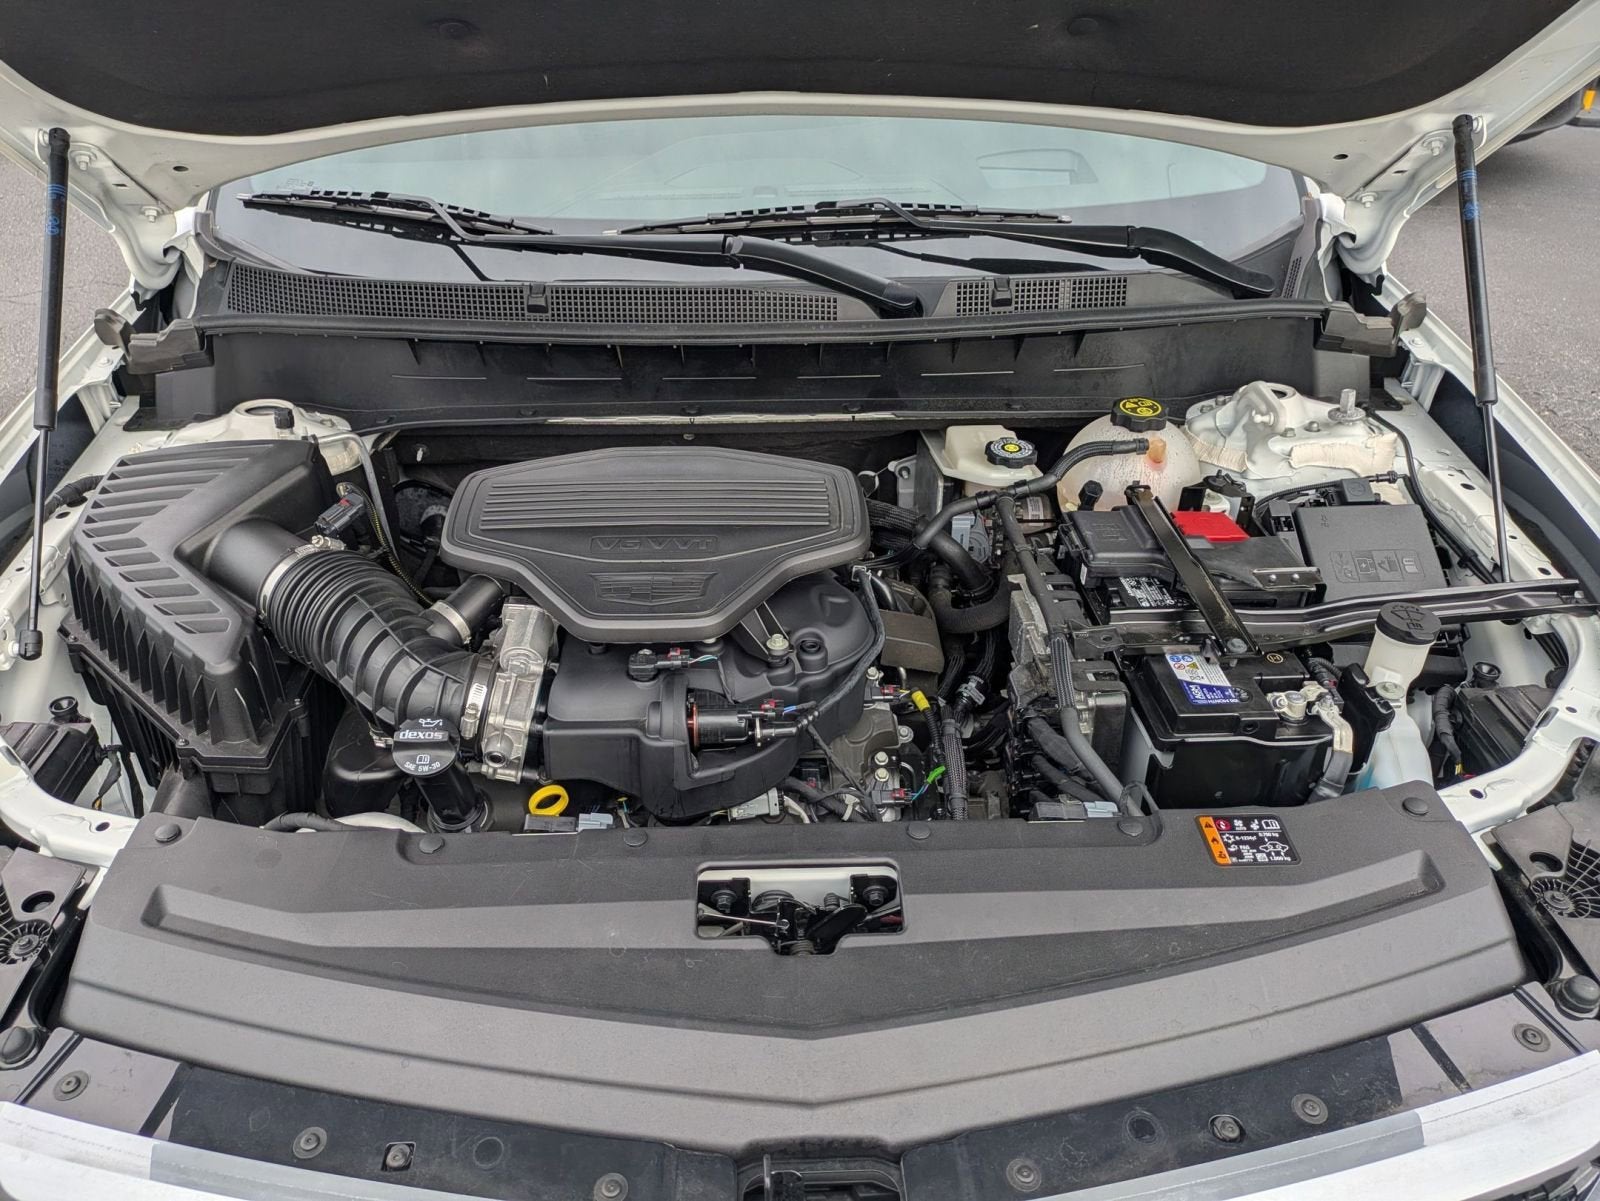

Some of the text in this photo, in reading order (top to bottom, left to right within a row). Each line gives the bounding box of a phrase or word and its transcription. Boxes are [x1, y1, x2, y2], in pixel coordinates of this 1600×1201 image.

[596, 537, 713, 550] V6 VVT
[400, 730, 444, 739] dexos
[418, 761, 440, 772] 5W-30
